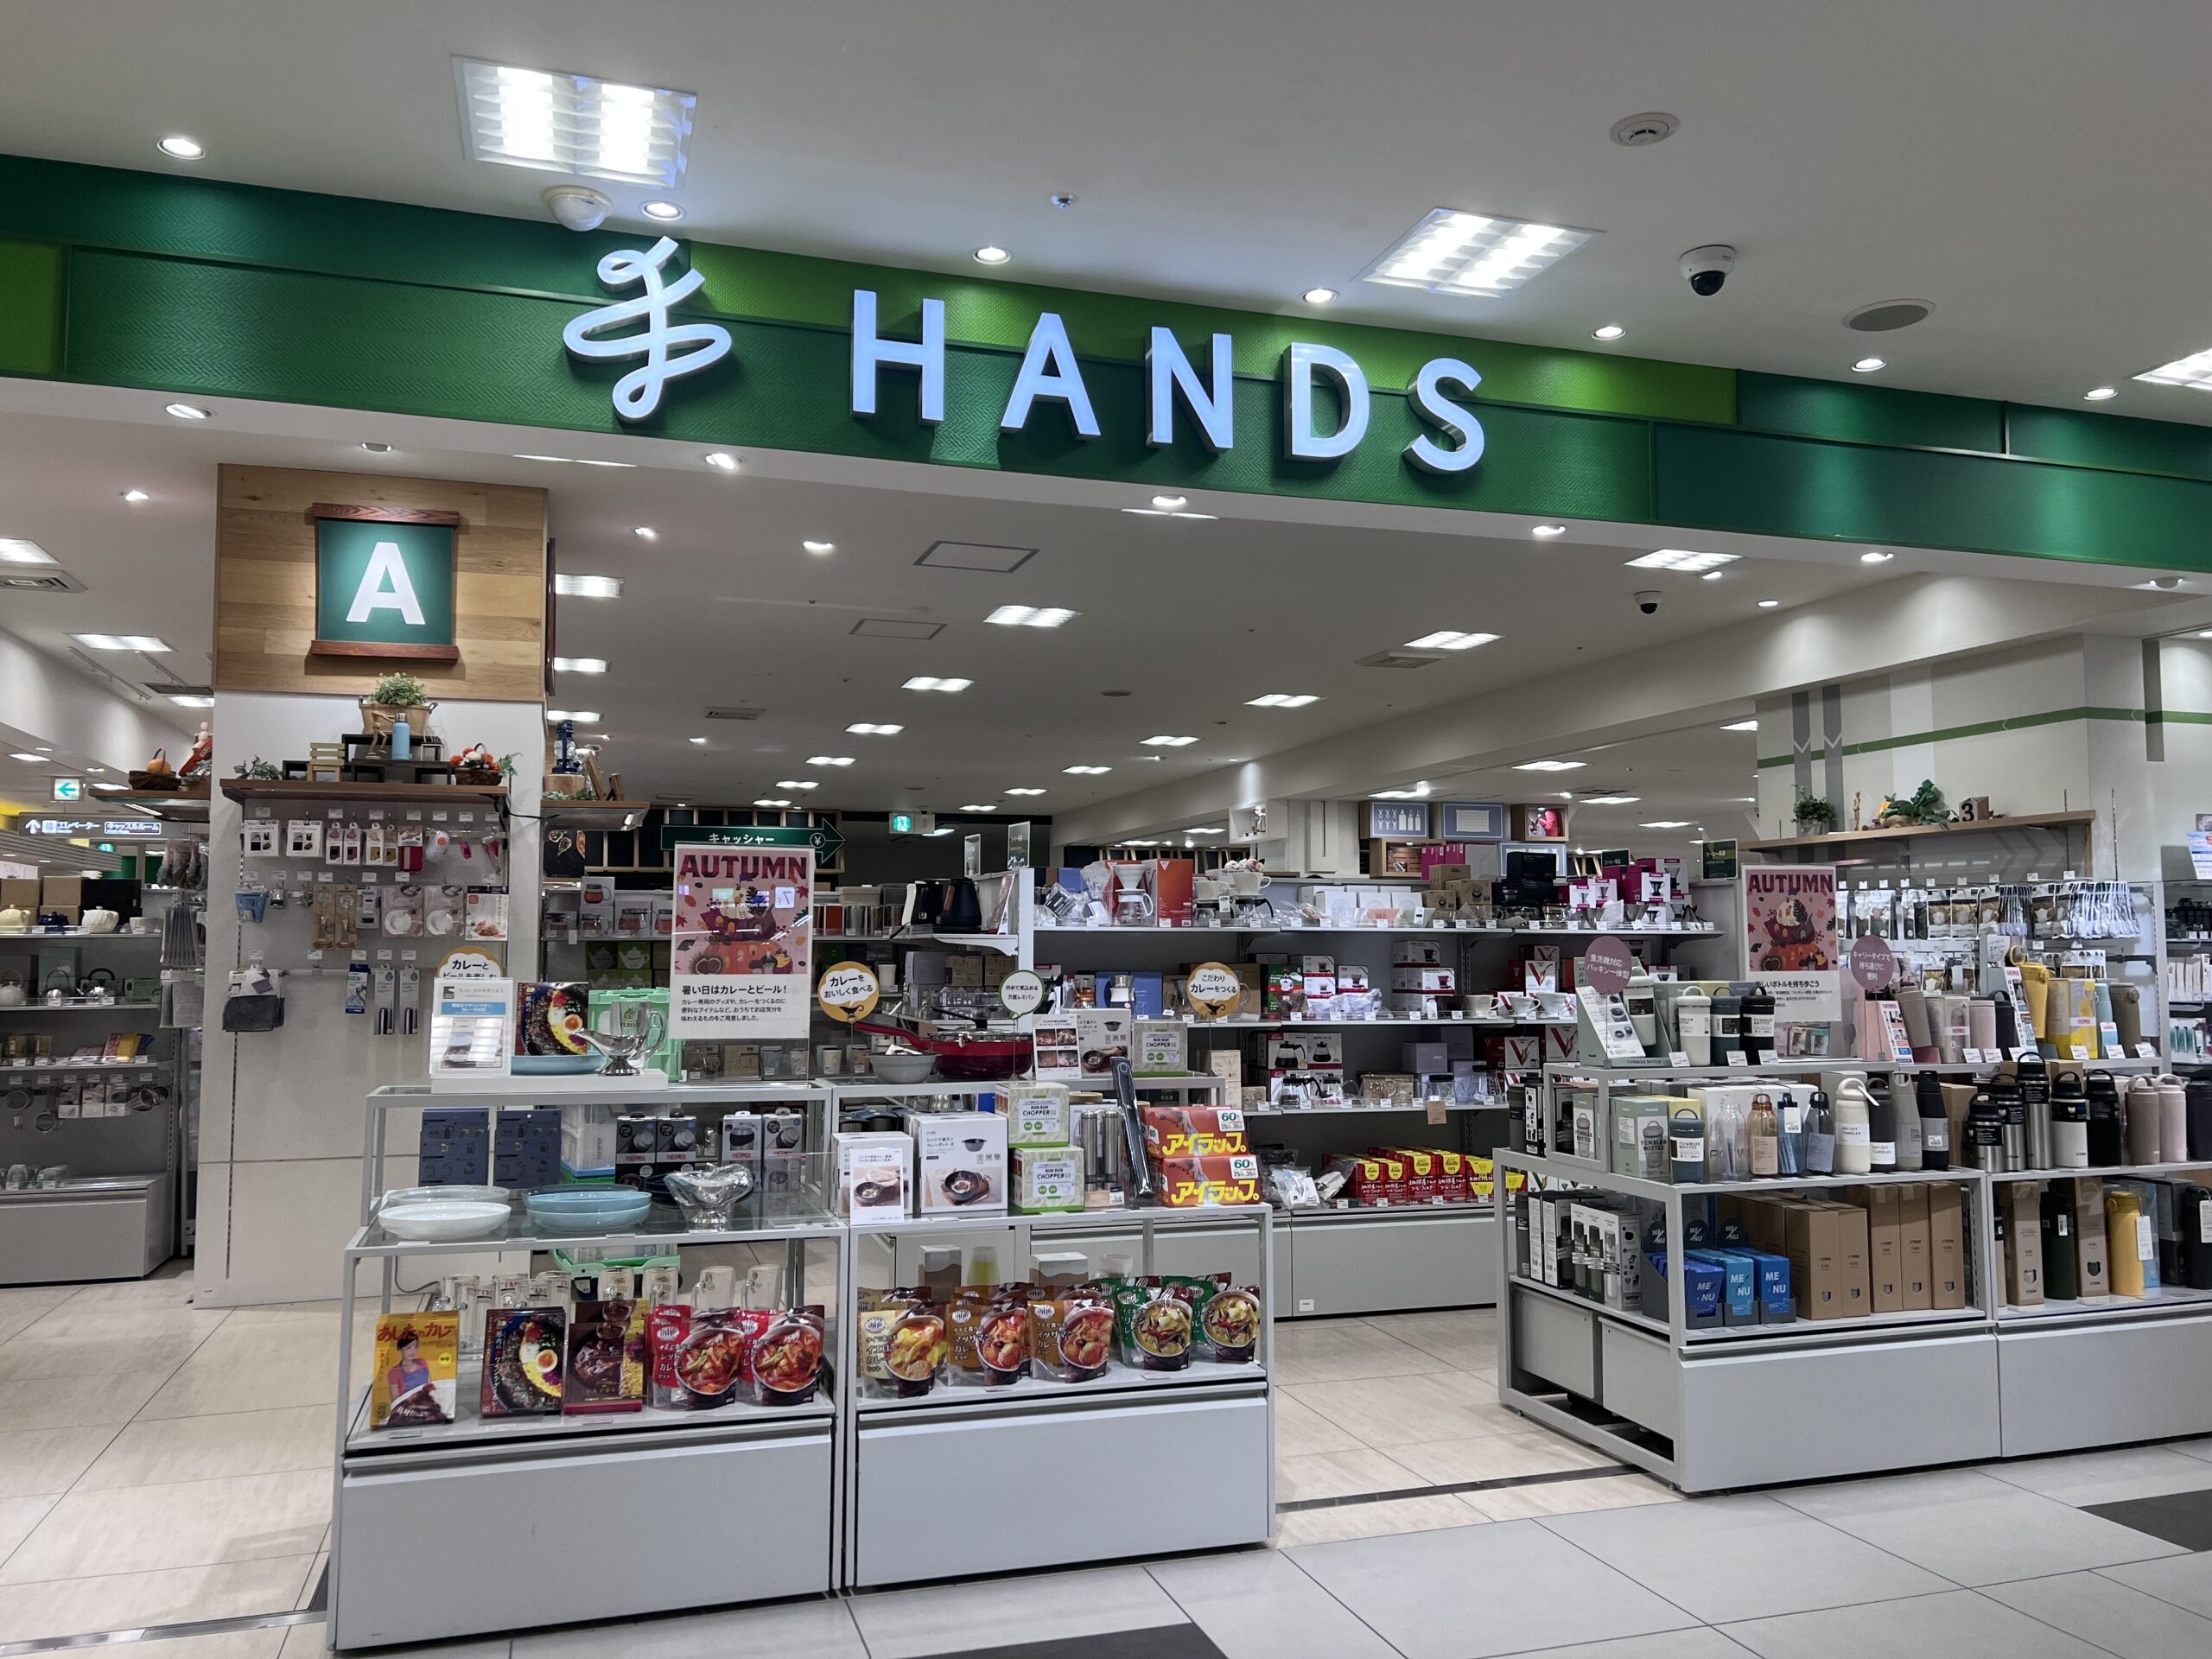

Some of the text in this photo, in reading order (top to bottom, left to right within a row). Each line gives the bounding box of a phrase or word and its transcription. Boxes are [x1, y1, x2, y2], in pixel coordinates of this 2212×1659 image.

[851, 289, 1486, 474] HANDS
[346, 542, 426, 625] A
[1961, 803, 1974, 822] 3
[709, 833, 775, 845] キャッシャー
[679, 855, 808, 880] AUTUMN
[1748, 874, 1834, 893] AUTUMN
[1853, 952, 1891, 961] キャリータイプで
[452, 959, 489, 969] カレーと
[1859, 963, 1885, 971] 持ち運びに
[830, 974, 865, 988] カレーを
[682, 985, 787, 995] 暑い日はカレーとビール!
[824, 984, 874, 999] おいしく食べる
[1191, 983, 1237, 994] カレーをつくる
[1162, 1132, 1247, 1156] アイラップ
[1171, 1179, 1260, 1204] アイラップ
[1730, 1274, 1745, 1283] ME
[1765, 1272, 1780, 1281] ME
[1696, 1282, 1712, 1291] ME
[1738, 1287, 1751, 1296] NU
[1772, 1284, 1786, 1294] NU
[377, 1322, 456, 1341] あしたのカレー
[866, 1344, 898, 1354] イエロー
[954, 1344, 978, 1354] カレー
[660, 1352, 681, 1362] レッド
[866, 1356, 891, 1365] カレー
[659, 1363, 683, 1372] カレー
